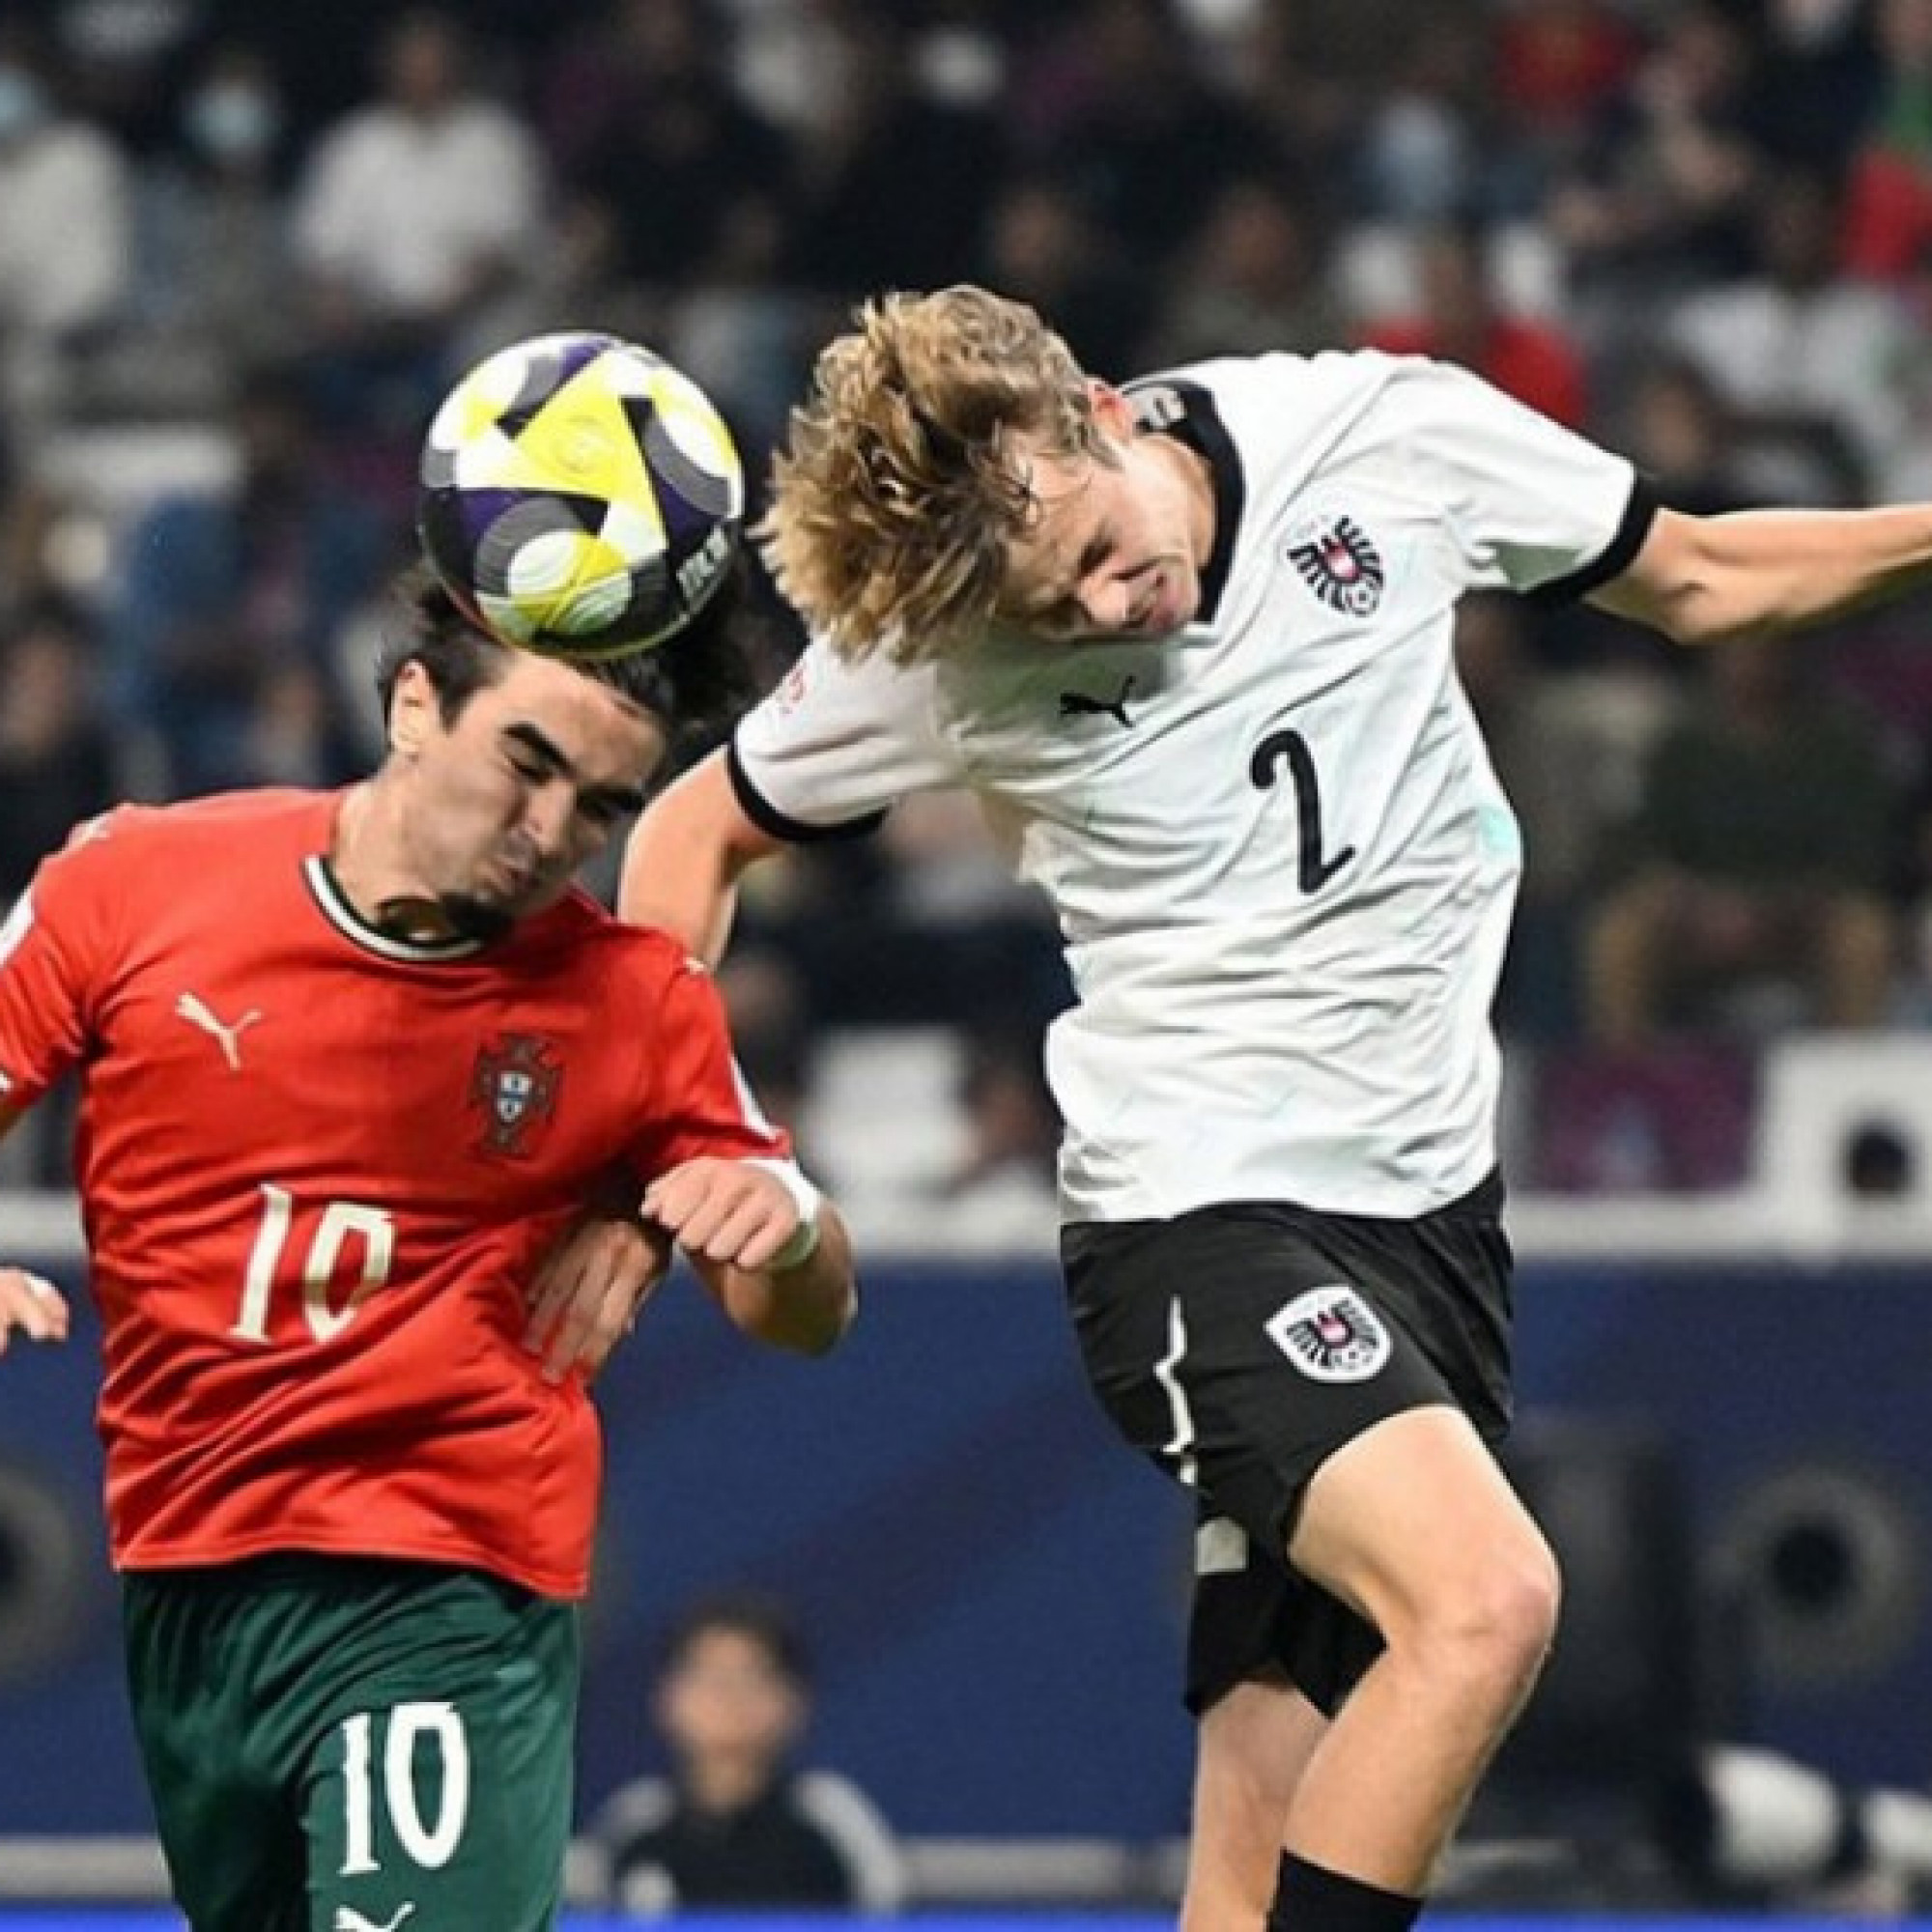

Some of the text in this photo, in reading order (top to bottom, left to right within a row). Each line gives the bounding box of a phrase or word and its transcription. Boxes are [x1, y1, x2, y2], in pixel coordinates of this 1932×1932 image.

[1249, 728, 1355, 895] 2
[227, 1182, 396, 1345] 10
[338, 1701, 470, 1876] 10
